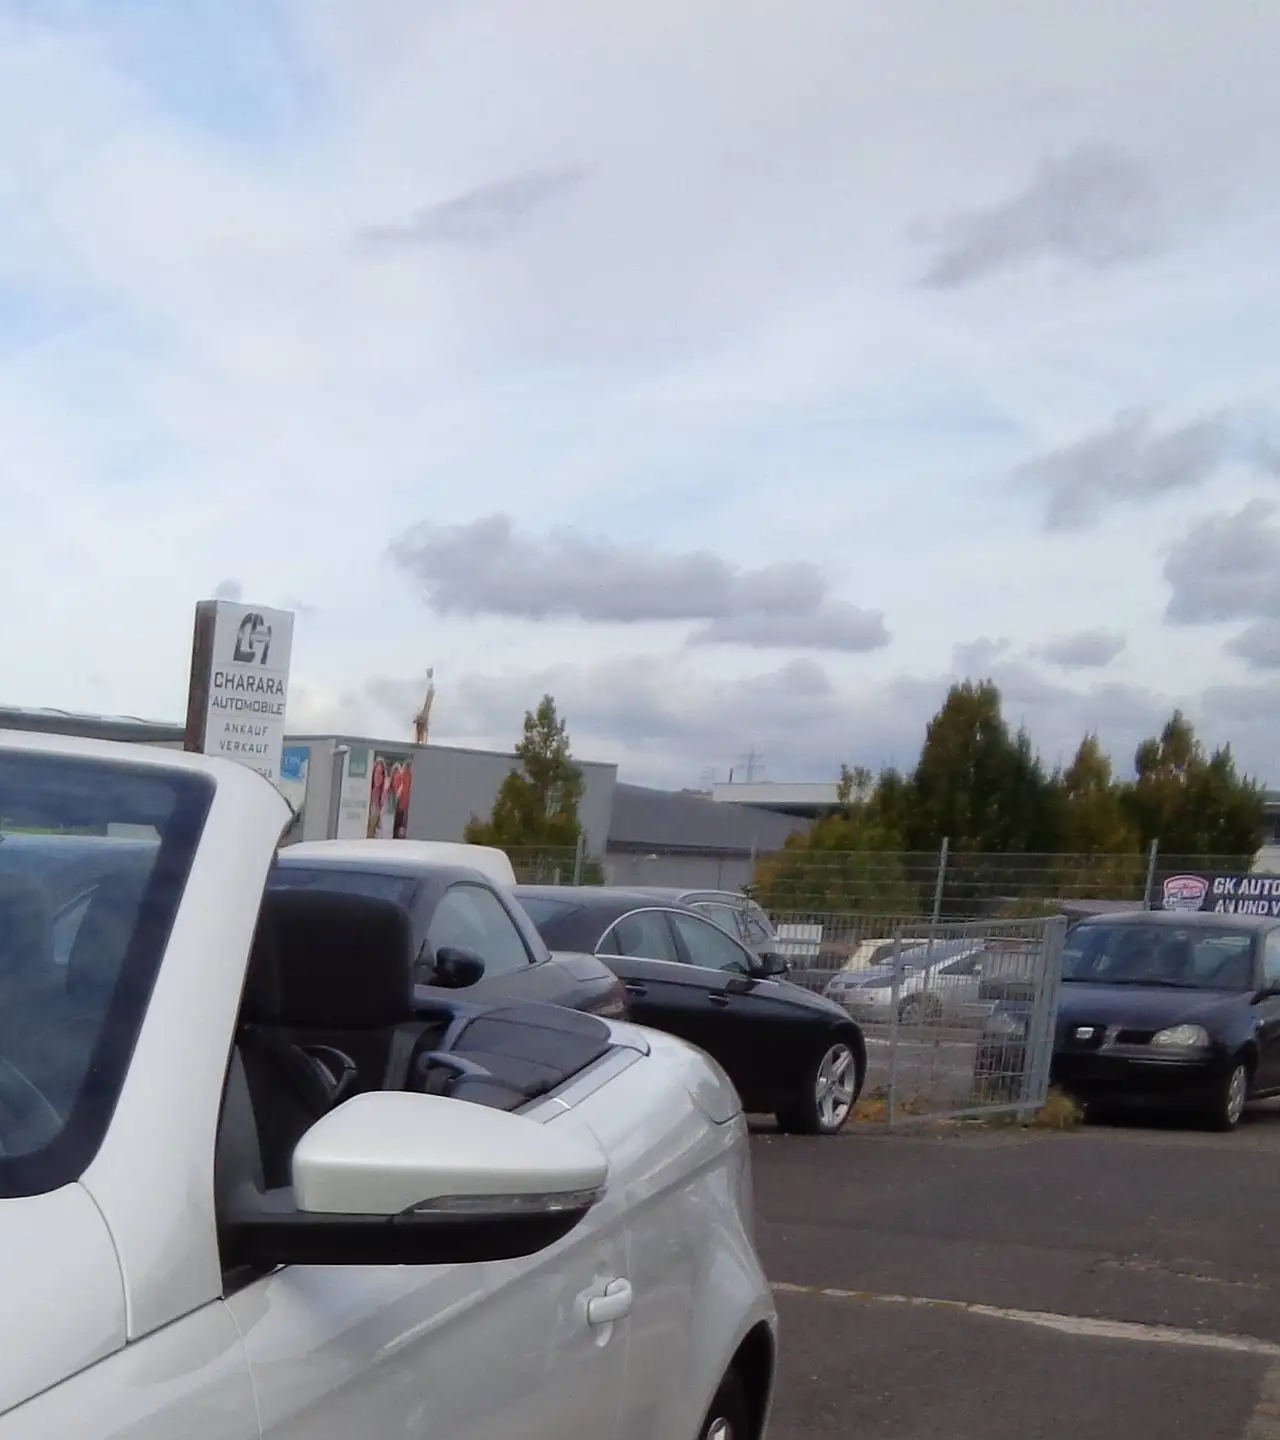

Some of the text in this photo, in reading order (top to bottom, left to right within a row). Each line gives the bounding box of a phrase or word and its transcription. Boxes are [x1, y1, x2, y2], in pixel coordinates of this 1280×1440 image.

[214, 672, 284, 695] CHARARA
[212, 696, 284, 715] AUTOMOBILE
[224, 722, 268, 736] ANKAUF
[220, 740, 269, 754] VERKAUF
[1213, 877, 1237, 894] GK
[1238, 900, 1269, 914] UND
